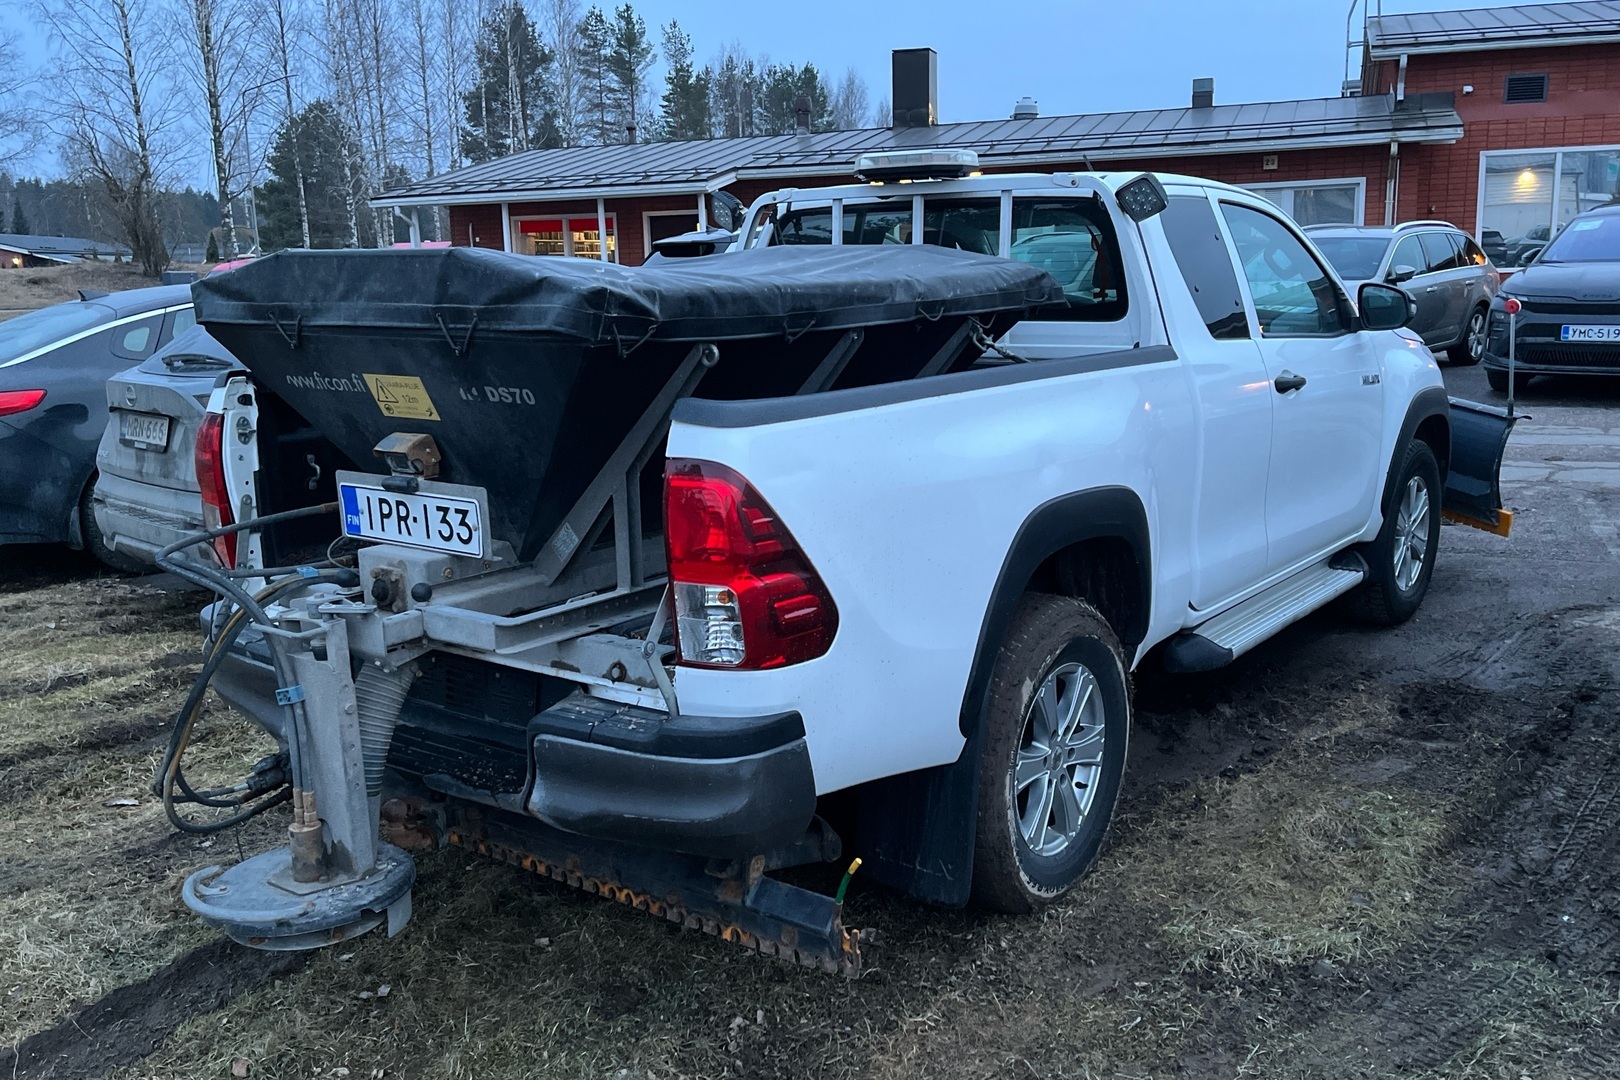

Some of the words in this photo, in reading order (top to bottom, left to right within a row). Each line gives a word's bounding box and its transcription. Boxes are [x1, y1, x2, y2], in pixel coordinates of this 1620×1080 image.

[1571, 328, 1620, 339] YMC-519
[483, 386, 536, 405] DS70
[347, 514, 359, 526] FIN
[366, 495, 473, 545] IPR-133
